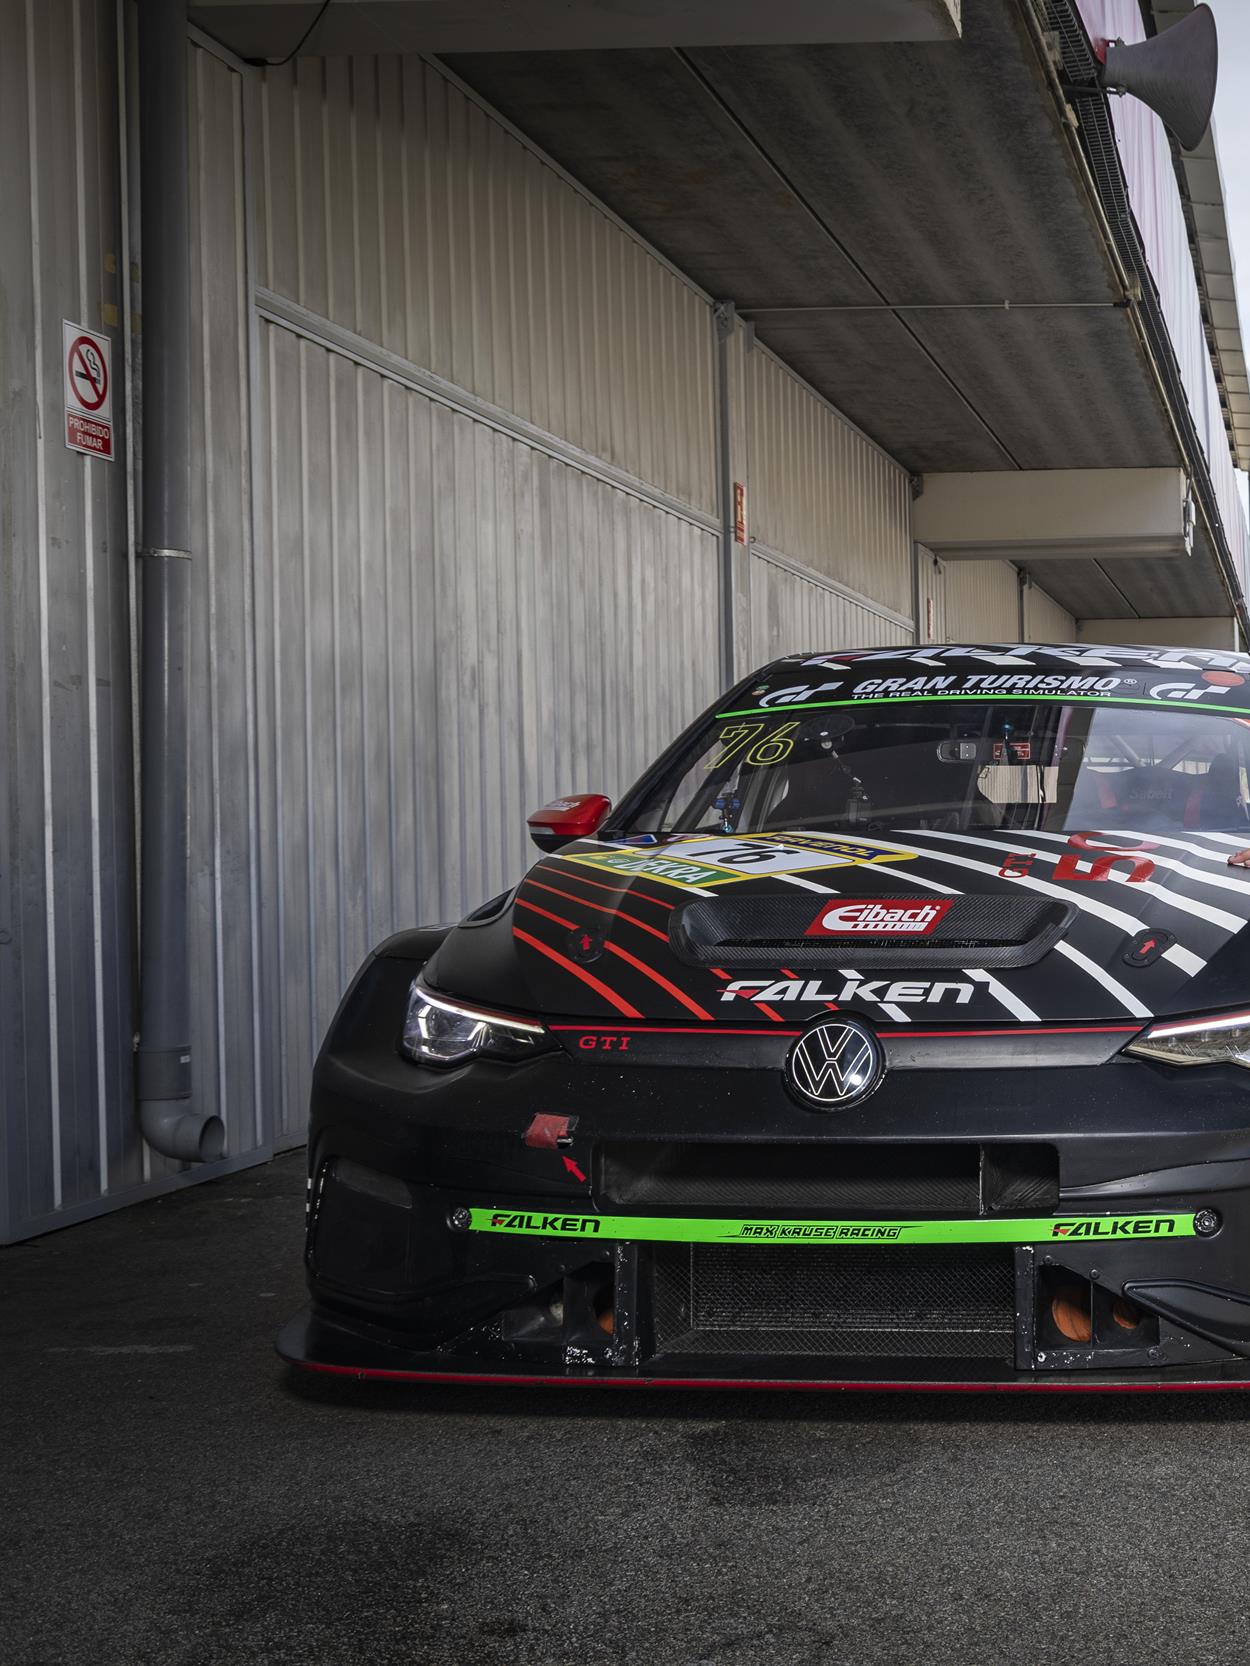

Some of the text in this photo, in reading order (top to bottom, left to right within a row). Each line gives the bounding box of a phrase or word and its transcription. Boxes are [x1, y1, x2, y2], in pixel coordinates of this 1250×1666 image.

[69, 416, 110, 439] PROHIBIDO
[76, 431, 104, 450] FUMAR
[800, 646, 1241, 668] FALKEN
[852, 675, 958, 694] GRAN
[888, 690, 932, 698] REAL
[937, 688, 1001, 696] DRIVING
[1011, 688, 1112, 697] SIMULATOR
[703, 721, 801, 769] 76
[685, 842, 801, 865] 76
[766, 833, 876, 861] RAVENOL
[613, 857, 717, 884] DEKRA
[822, 904, 940, 931] Eibach
[718, 979, 975, 1003] FALKEN
[578, 1035, 631, 1050] GTI
[490, 1213, 601, 1233] FALKEN
[741, 1225, 778, 1238] MAX
[837, 1226, 900, 1239] RACING
[1051, 1219, 1175, 1237] FALKEN
